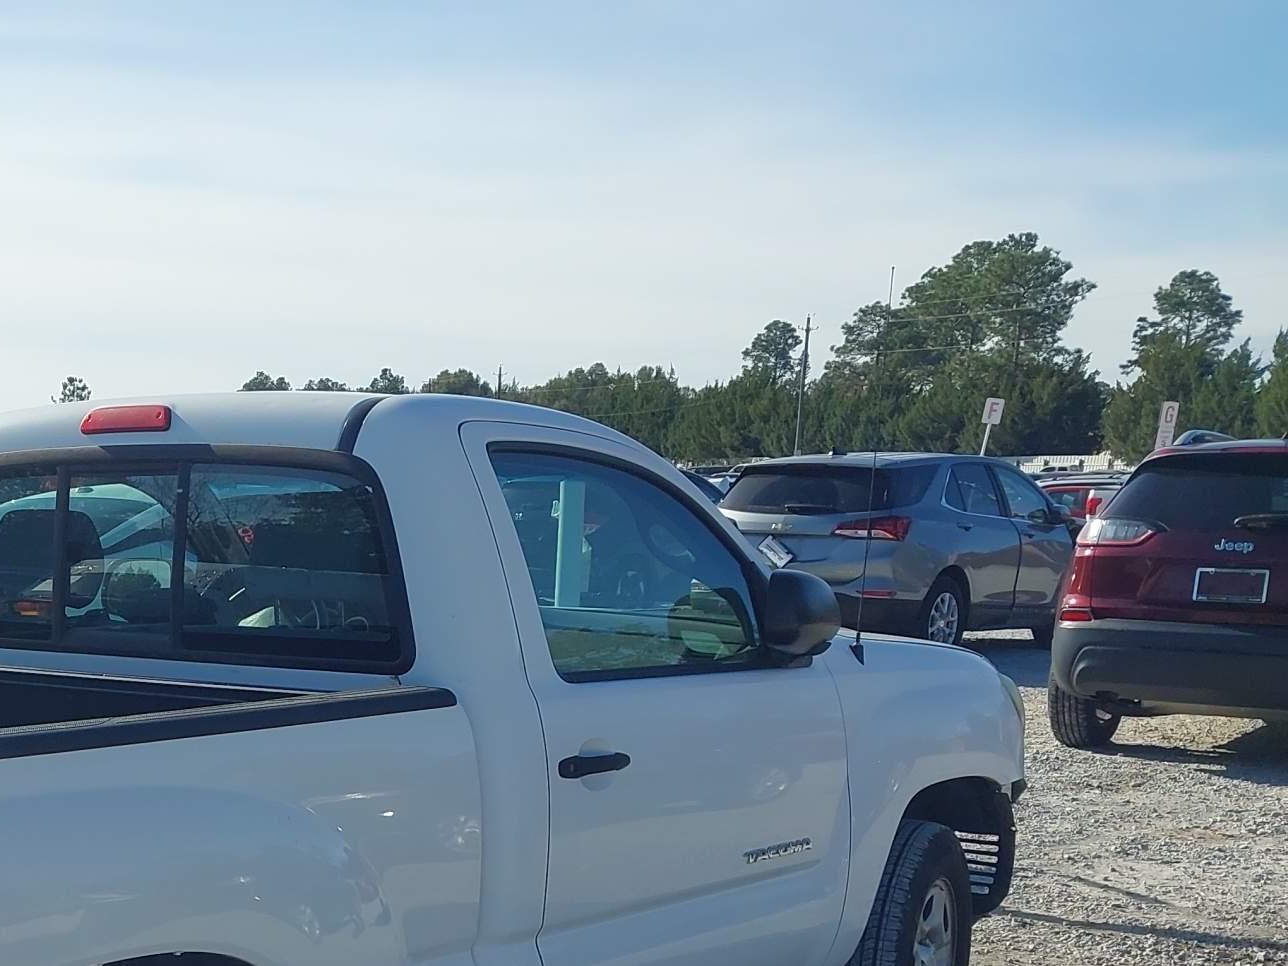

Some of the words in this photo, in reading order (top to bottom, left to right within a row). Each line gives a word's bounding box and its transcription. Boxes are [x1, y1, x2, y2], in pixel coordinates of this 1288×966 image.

[987, 401, 1000, 419] F
[1164, 405, 1175, 423] G
[1214, 538, 1255, 554] Jeep
